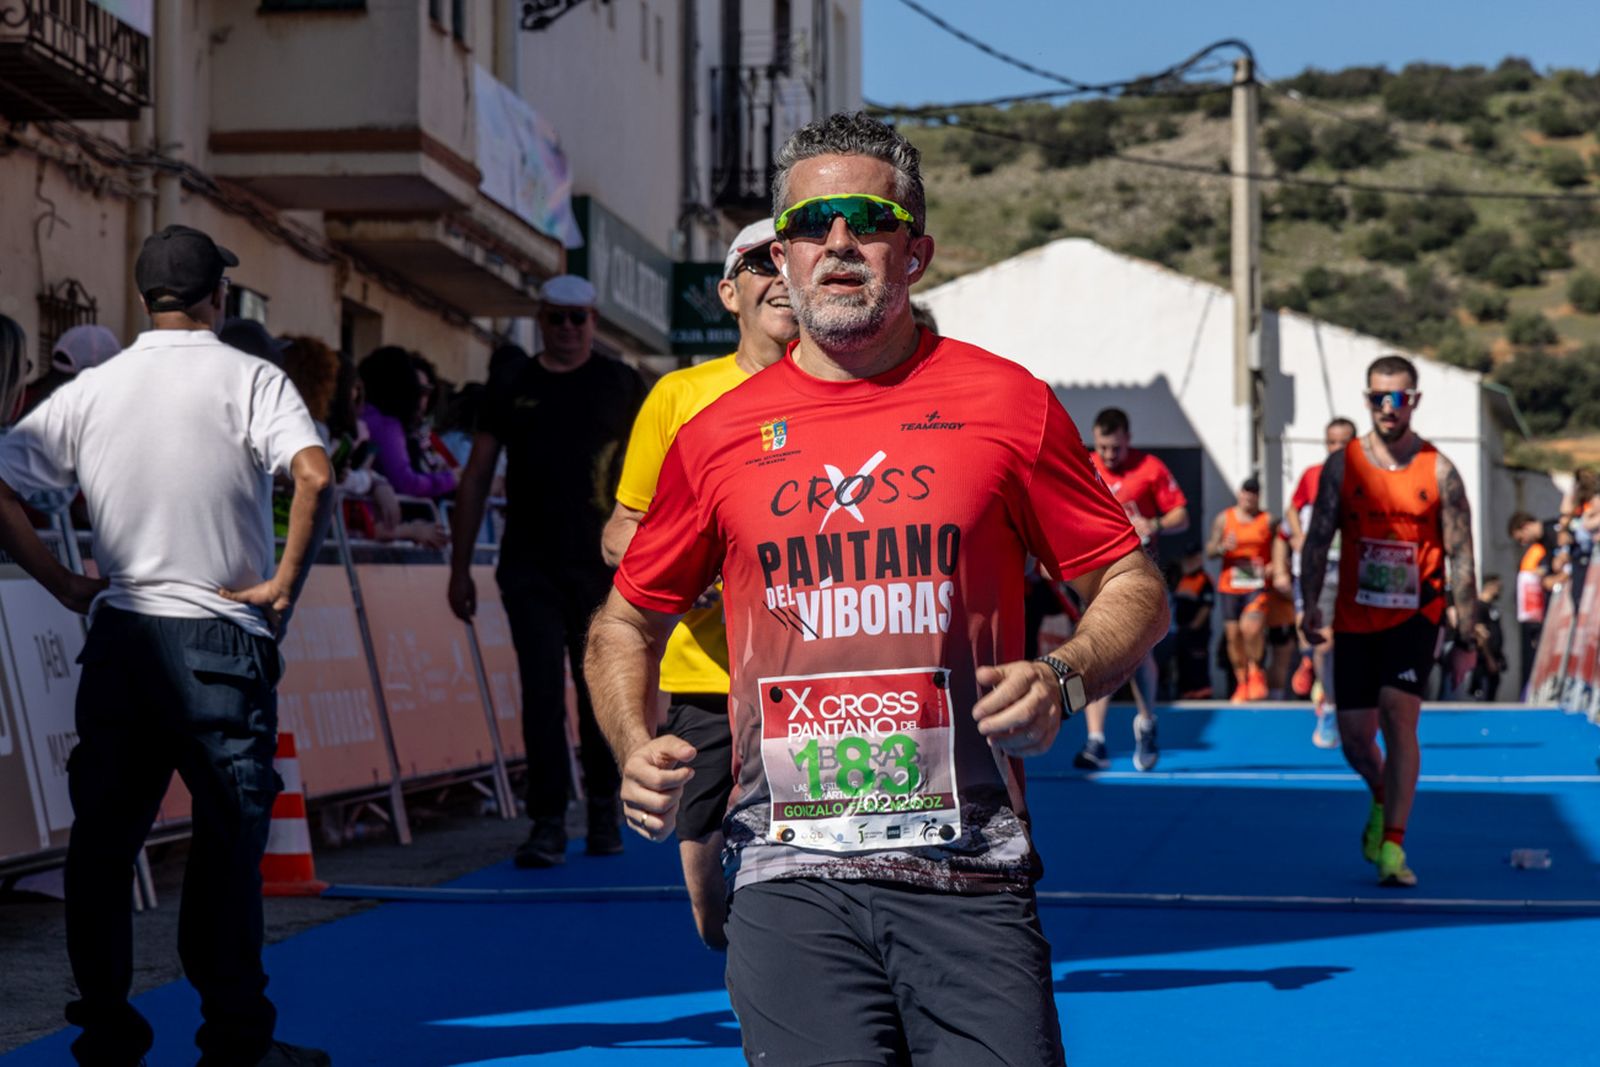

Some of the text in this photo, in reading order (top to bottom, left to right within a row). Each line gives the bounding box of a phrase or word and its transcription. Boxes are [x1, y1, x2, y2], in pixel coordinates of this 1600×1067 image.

[900, 421, 966, 431] TEAMERGY
[770, 465, 936, 517] CROSS
[757, 523, 961, 588] PANTANO
[765, 576, 955, 643] DEL VÍBORAS
[785, 686, 815, 721] X
[819, 691, 919, 719] CROSS
[788, 717, 920, 743] PANTANO DEL
[794, 733, 921, 799] 183
[784, 801, 844, 818] GONZALO
